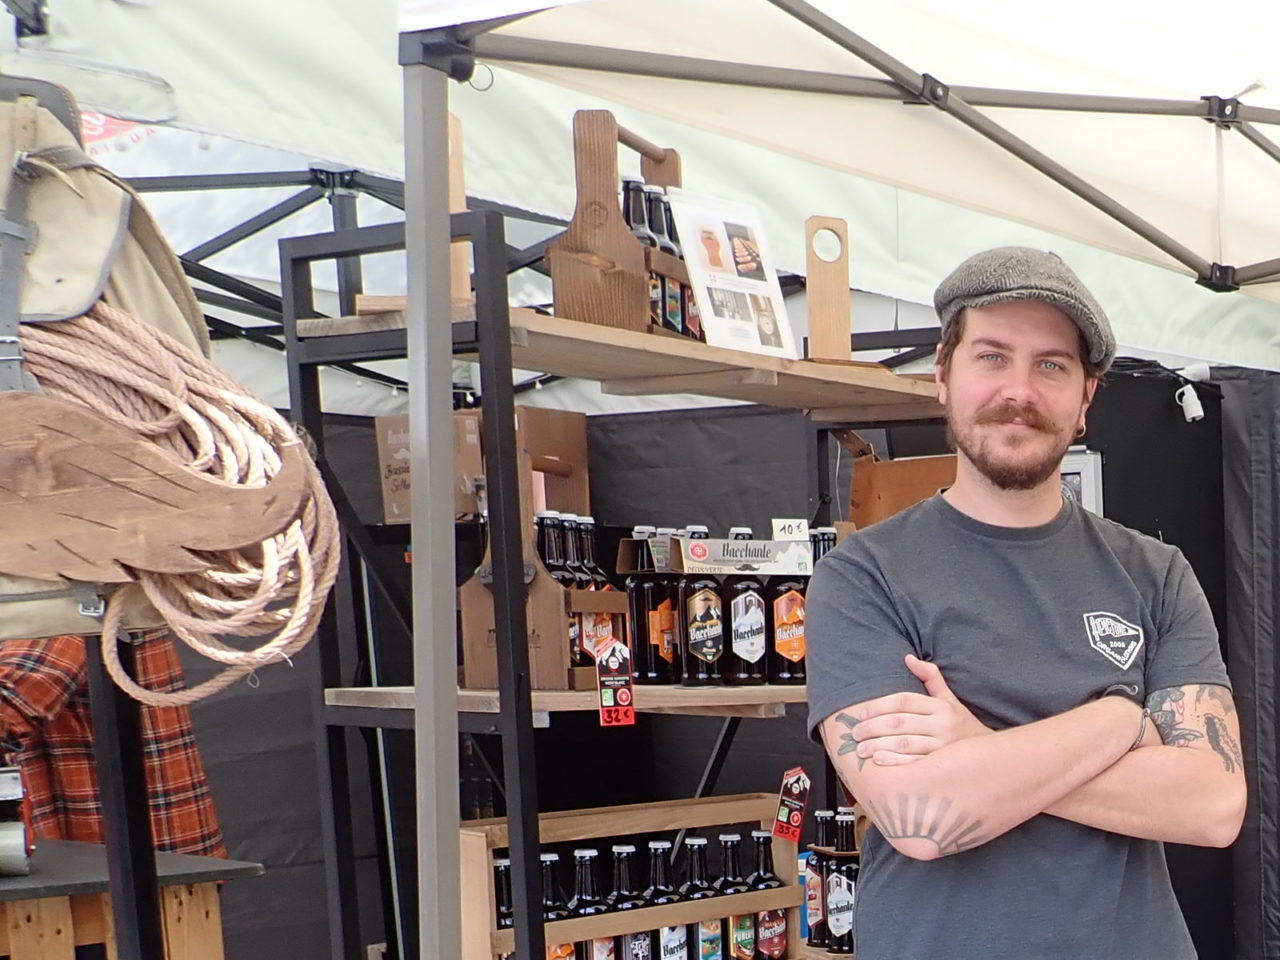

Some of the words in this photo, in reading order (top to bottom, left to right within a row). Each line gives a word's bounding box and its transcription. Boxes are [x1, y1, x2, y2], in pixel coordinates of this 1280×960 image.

[780, 523, 793, 535] 10
[722, 543, 771, 558] Bacchante
[604, 708, 621, 723] 32
[778, 823, 790, 835] 35
